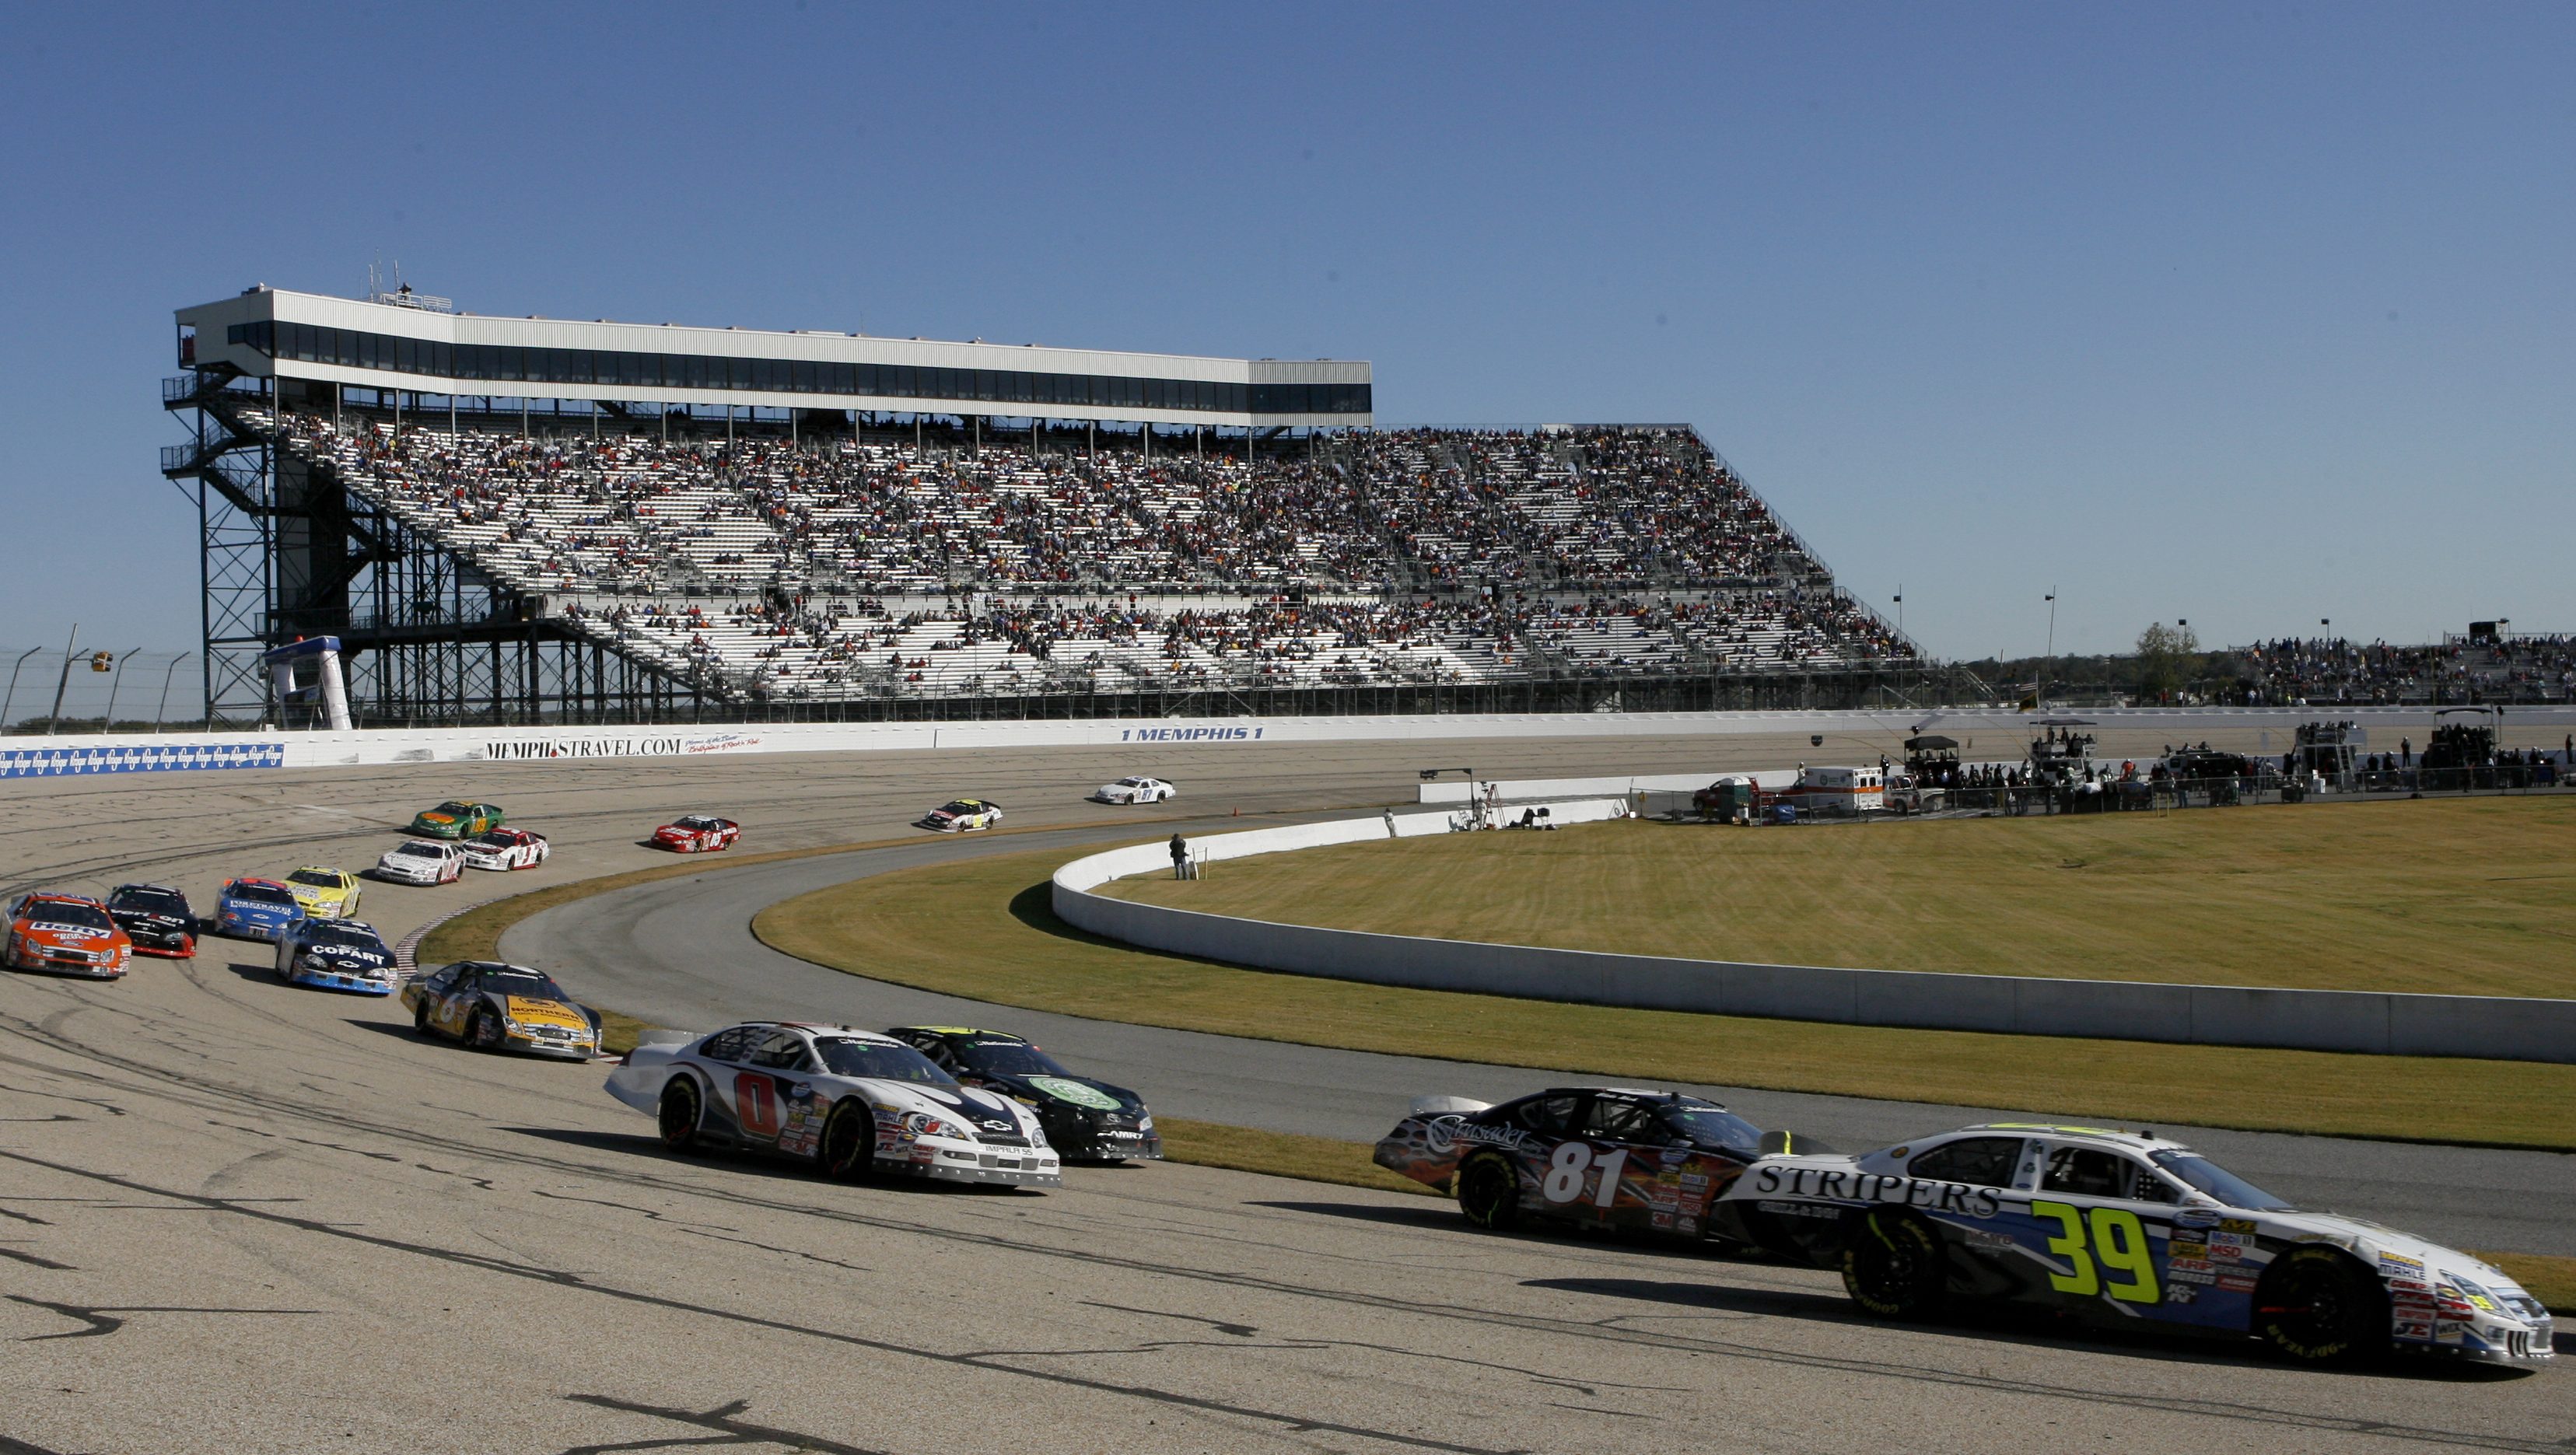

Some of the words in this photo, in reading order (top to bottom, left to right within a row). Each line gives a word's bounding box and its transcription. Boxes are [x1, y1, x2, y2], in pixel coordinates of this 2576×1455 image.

[1121, 729, 1129, 741] 1
[1137, 728, 1248, 741] MEMPHIS
[1255, 727, 1264, 739] 1
[14, 751, 32, 775] Kroger
[32, 751, 50, 775] Kroger
[51, 750, 68, 775] Kroger
[70, 750, 87, 773] Kroger
[88, 750, 105, 772] Kroger
[106, 749, 123, 771] Kroger
[124, 748, 141, 771] Kroger
[142, 748, 159, 770] Kroger
[159, 747, 177, 769] Kroger
[177, 747, 194, 769] Kroger
[195, 747, 212, 768] Kroger
[213, 747, 229, 768] Kroger
[248, 746, 265, 766] Kroger
[265, 745, 282, 766] Kroger
[312, 945, 385, 965] COPART
[511, 1007, 579, 1020] NORTHERN
[735, 1072, 778, 1139] 0
[874, 1113, 904, 1124] MAHLE
[1426, 1115, 1533, 1153] Crusader
[985, 1145, 1020, 1154] IMPALA
[1543, 1141, 1629, 1208] 81
[1756, 1165, 2002, 1219] STRIPERS
[2030, 1199, 2161, 1304] 39
[2210, 1244, 2242, 1257] MSD
[2171, 1258, 2215, 1271] ARP
[2378, 1264, 2426, 1280] MAHLE
